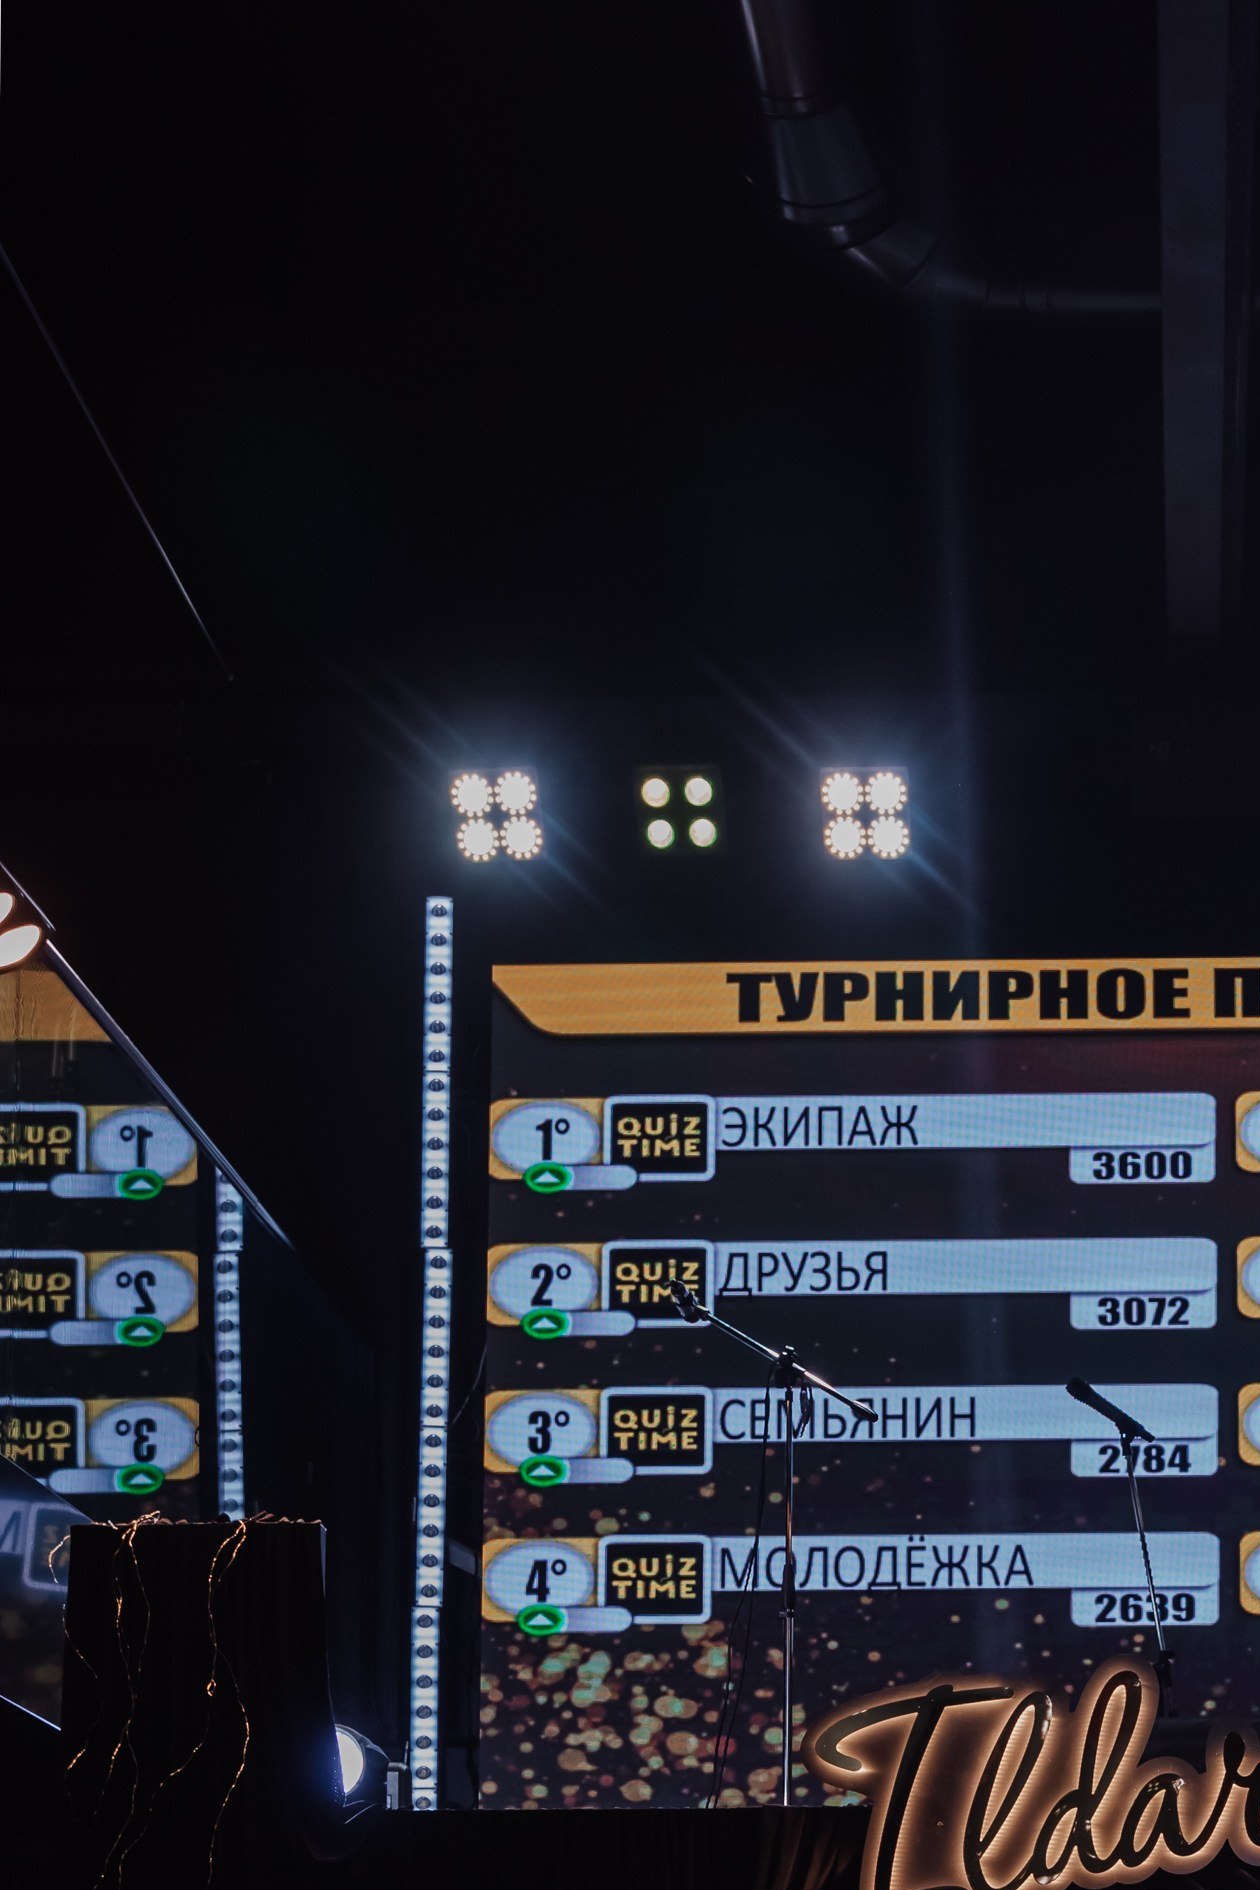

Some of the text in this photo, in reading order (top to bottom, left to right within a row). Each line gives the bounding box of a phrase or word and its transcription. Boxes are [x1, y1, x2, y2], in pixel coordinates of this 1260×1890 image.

[726, 967, 1191, 1023] ТУРНИРНОЕ
[721, 1105, 919, 1148] ЭКИПАЖ
[617, 1138, 700, 1158] TIME
[1091, 1150, 1192, 1181] 3600
[718, 1252, 889, 1297] ДРУЗЬЯ
[1098, 1297, 1191, 1327] 3072
[613, 1431, 698, 1452] TIME
[719, 1536, 1034, 1592] МОЛОДЁЖКА
[611, 1579, 697, 1600] TIME
[1093, 1593, 1196, 1623] 2639
